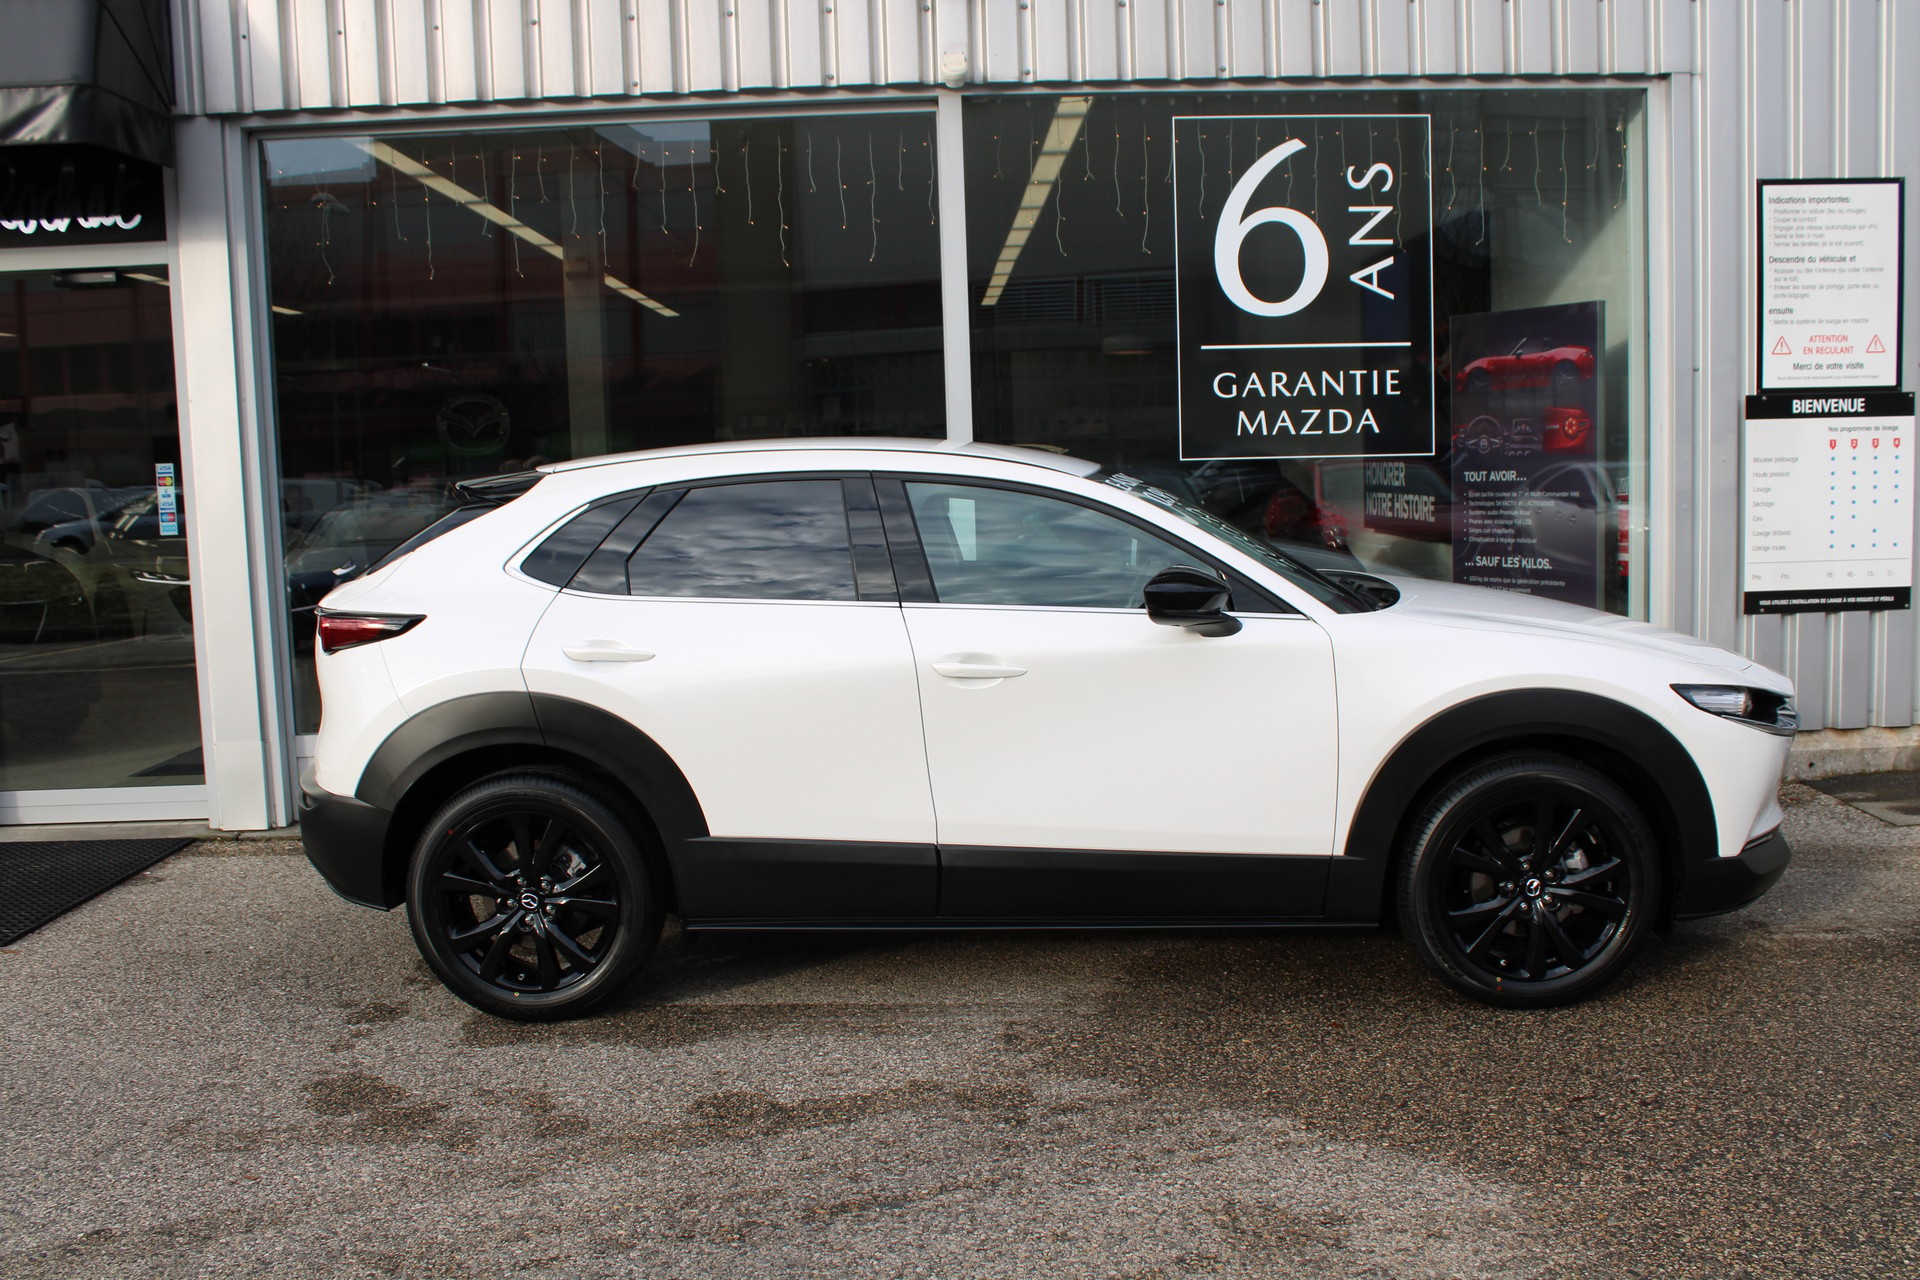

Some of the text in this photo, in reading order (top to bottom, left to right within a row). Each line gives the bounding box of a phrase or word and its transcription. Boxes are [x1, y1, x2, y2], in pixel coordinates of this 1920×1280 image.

[1769, 196, 1806, 204] Indications
[1214, 138, 1329, 317] 6
[1347, 162, 1394, 300] ANS
[1819, 254, 1847, 263] véhicule
[1769, 307, 1794, 315] ensuite
[1809, 335, 1848, 343] ATTENTION
[1803, 346, 1854, 355] EN RECULANT
[1792, 361, 1865, 371] Merci de votre visite
[1212, 369, 1401, 398] GARANTIE
[1792, 398, 1866, 414] BIENVENUE
[1237, 408, 1380, 436] MAZDA
[1365, 462, 1405, 486] HONORER
[1464, 471, 1488, 482] TOUT
[1366, 492, 1436, 522] NOTRE HISTOIRE
[1502, 557, 1520, 568] LES
[1521, 558, 1552, 569] KILOS.
